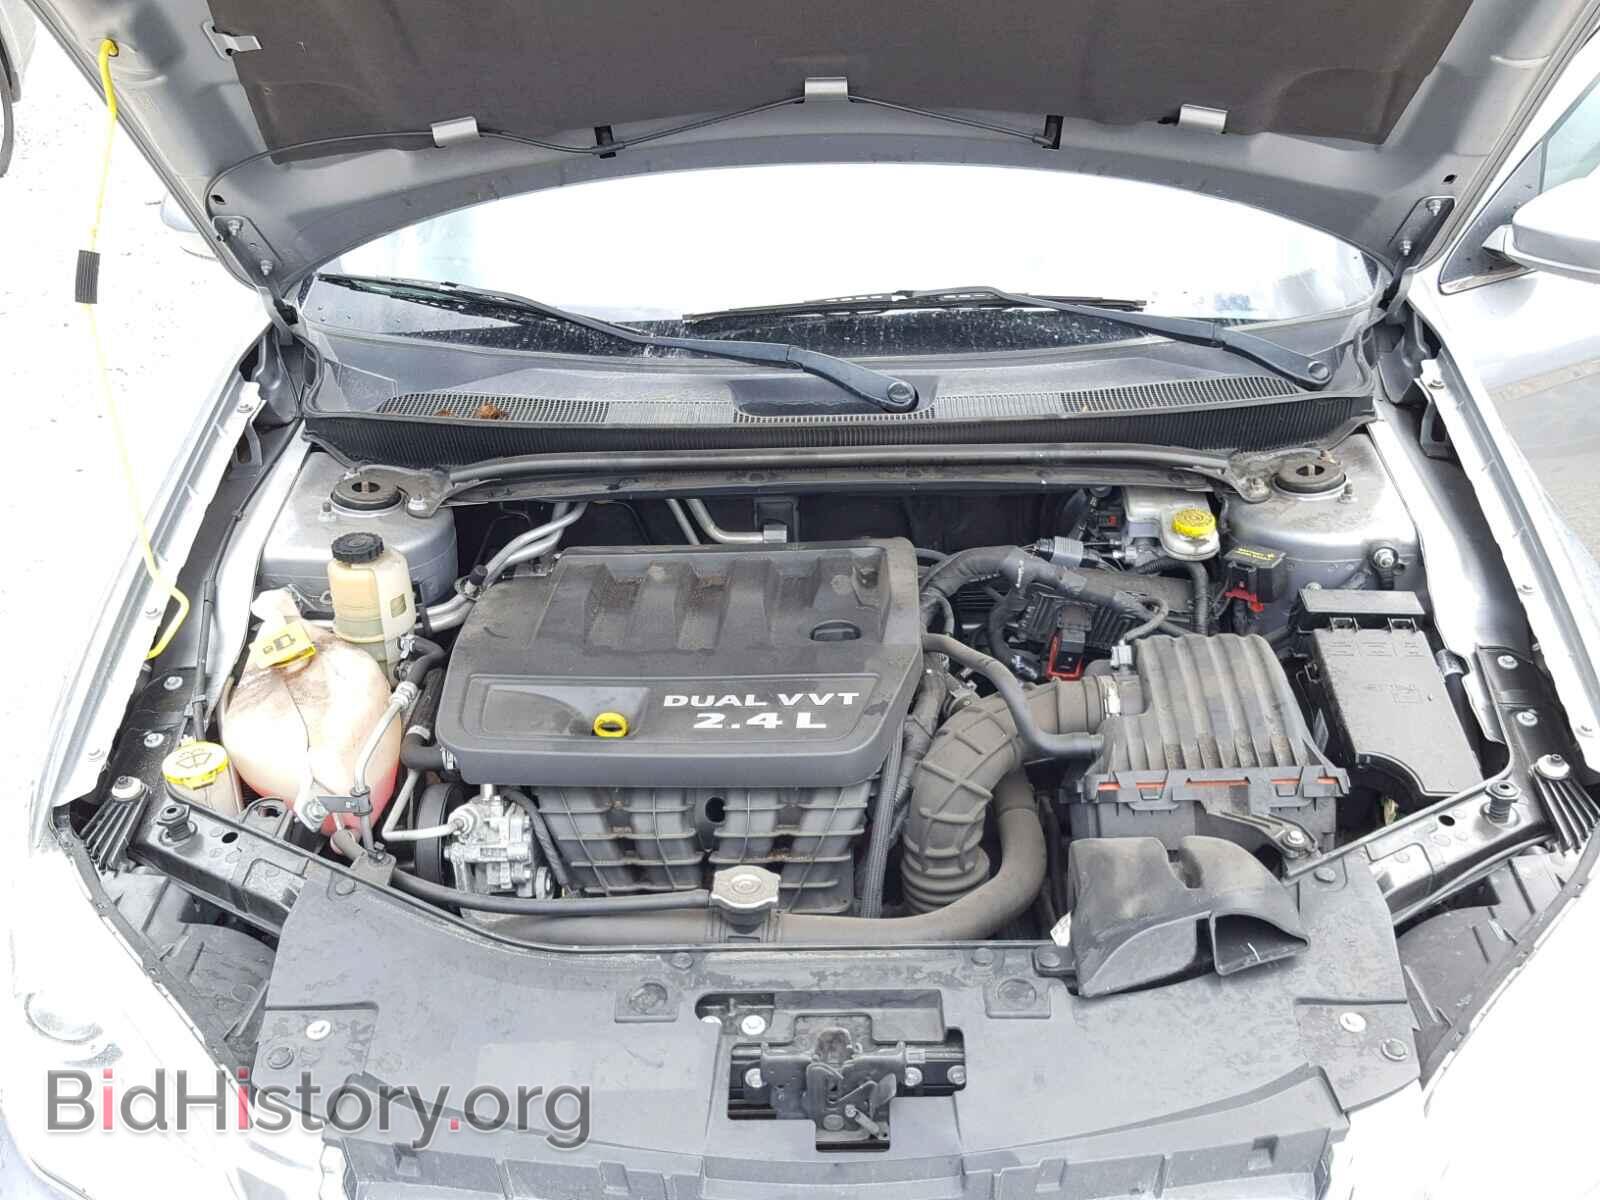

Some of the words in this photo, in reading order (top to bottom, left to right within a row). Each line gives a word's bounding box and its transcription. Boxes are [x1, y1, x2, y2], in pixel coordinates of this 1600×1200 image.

[663, 694, 767, 707] DUAL
[777, 692, 860, 706] VVT
[693, 712, 783, 729] 2.4
[796, 712, 827, 729] L
